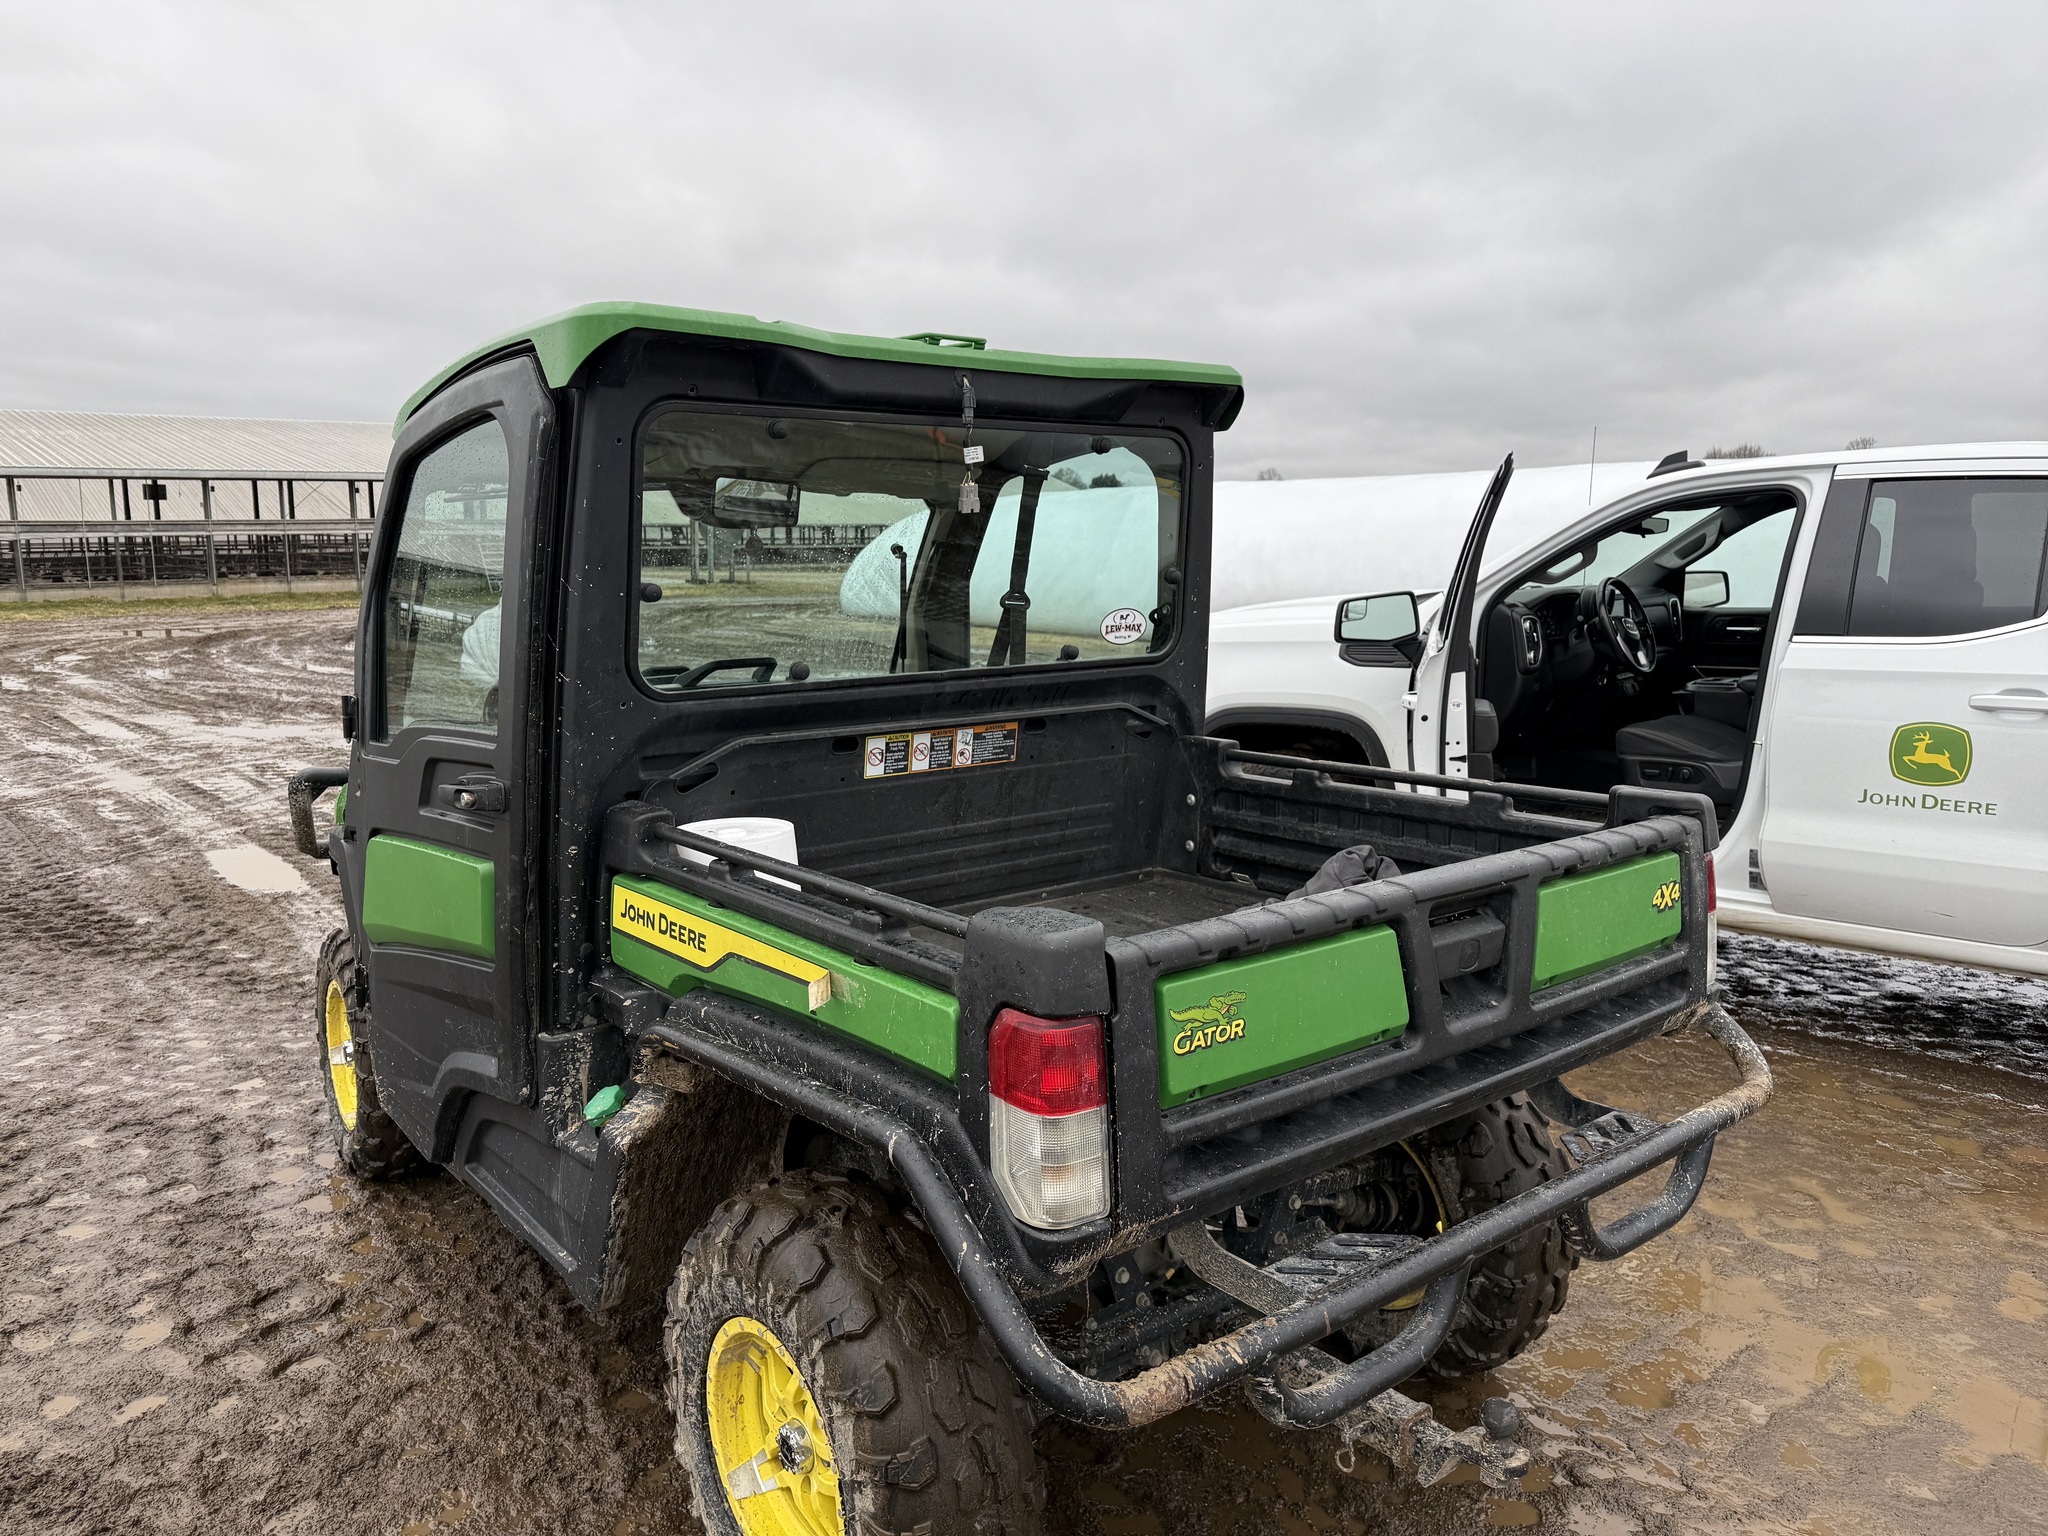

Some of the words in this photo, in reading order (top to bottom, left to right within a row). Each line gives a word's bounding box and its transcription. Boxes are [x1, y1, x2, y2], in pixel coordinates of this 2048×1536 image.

[1858, 789, 1916, 808] JOHN
[1921, 794, 1997, 816] DEERE
[620, 898, 655, 931] JOHN
[658, 912, 706, 953] DEERE
[1173, 1018, 1245, 1056] GATOR
